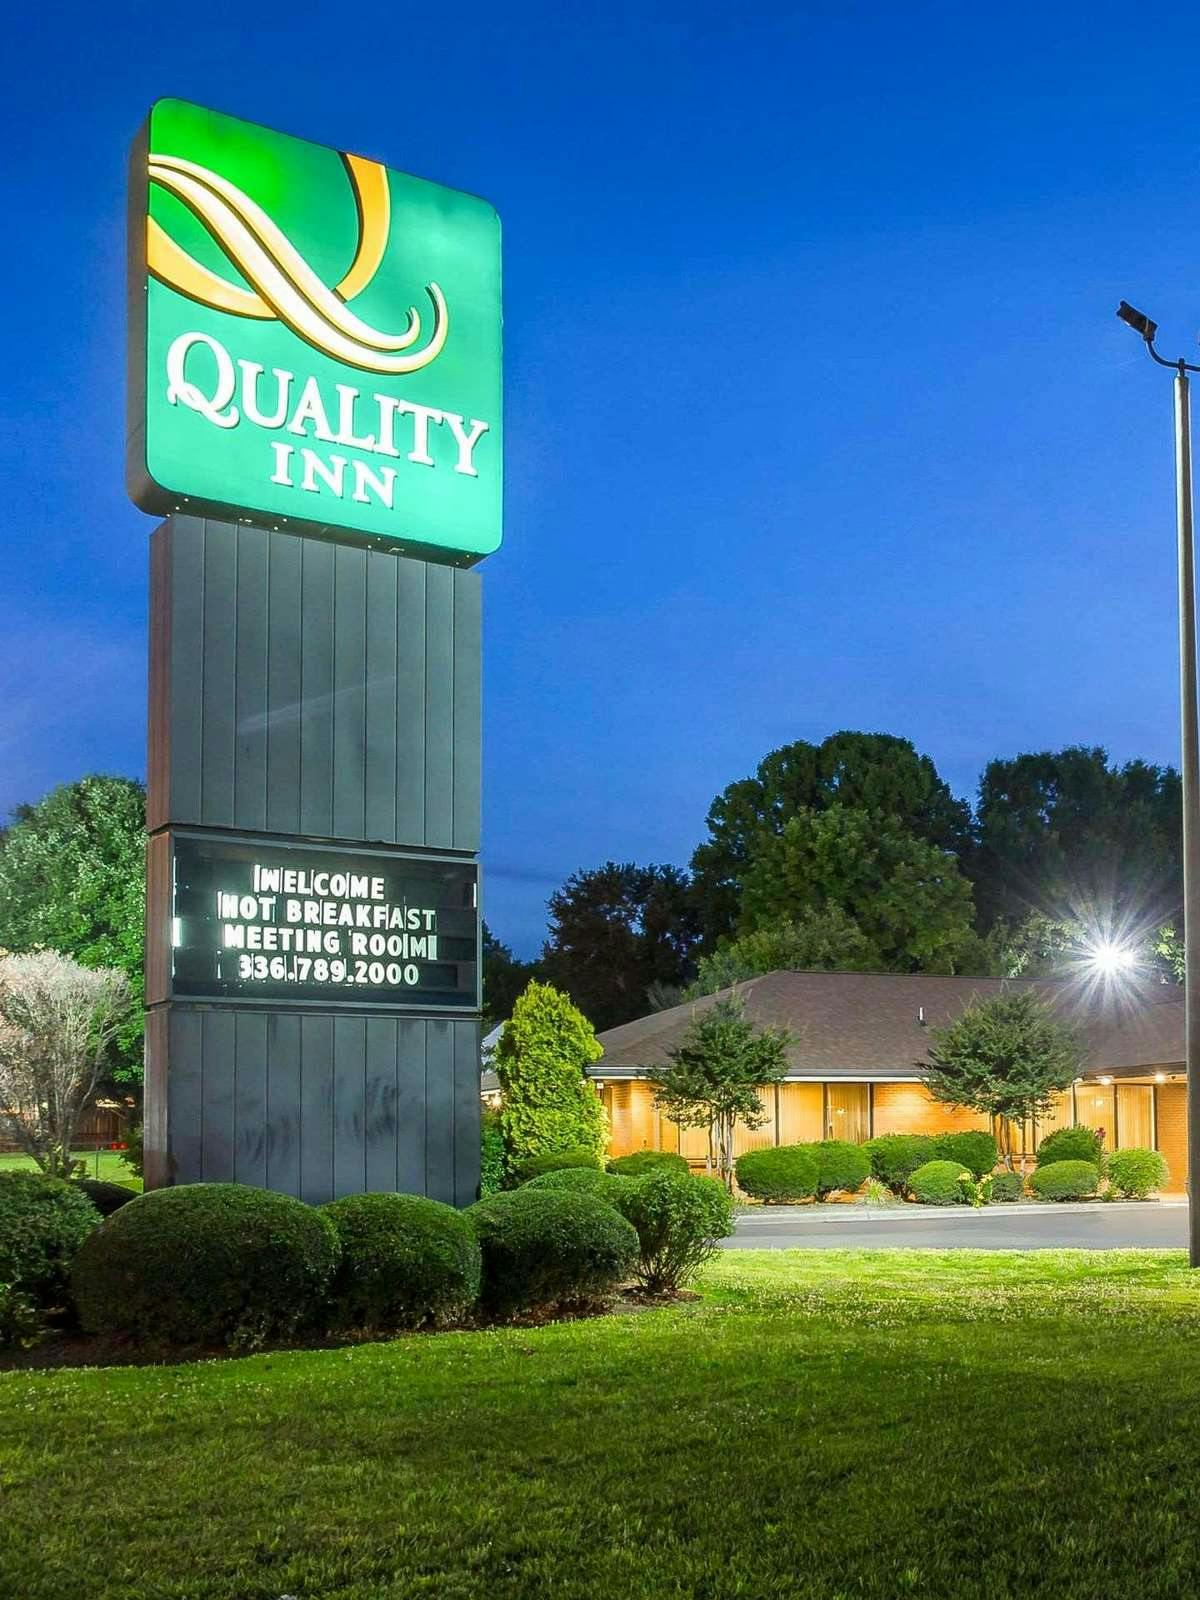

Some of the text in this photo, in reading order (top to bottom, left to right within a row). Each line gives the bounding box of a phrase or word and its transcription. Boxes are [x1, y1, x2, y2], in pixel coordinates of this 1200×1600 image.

[166, 331, 490, 478] QUALITY
[270, 441, 398, 509] INN
[259, 867, 385, 899] WELCOME
[221, 895, 436, 930] HOT BREAKFAST
[224, 924, 428, 958] MEETING ROOM
[238, 954, 420, 985] 336.789.2000
